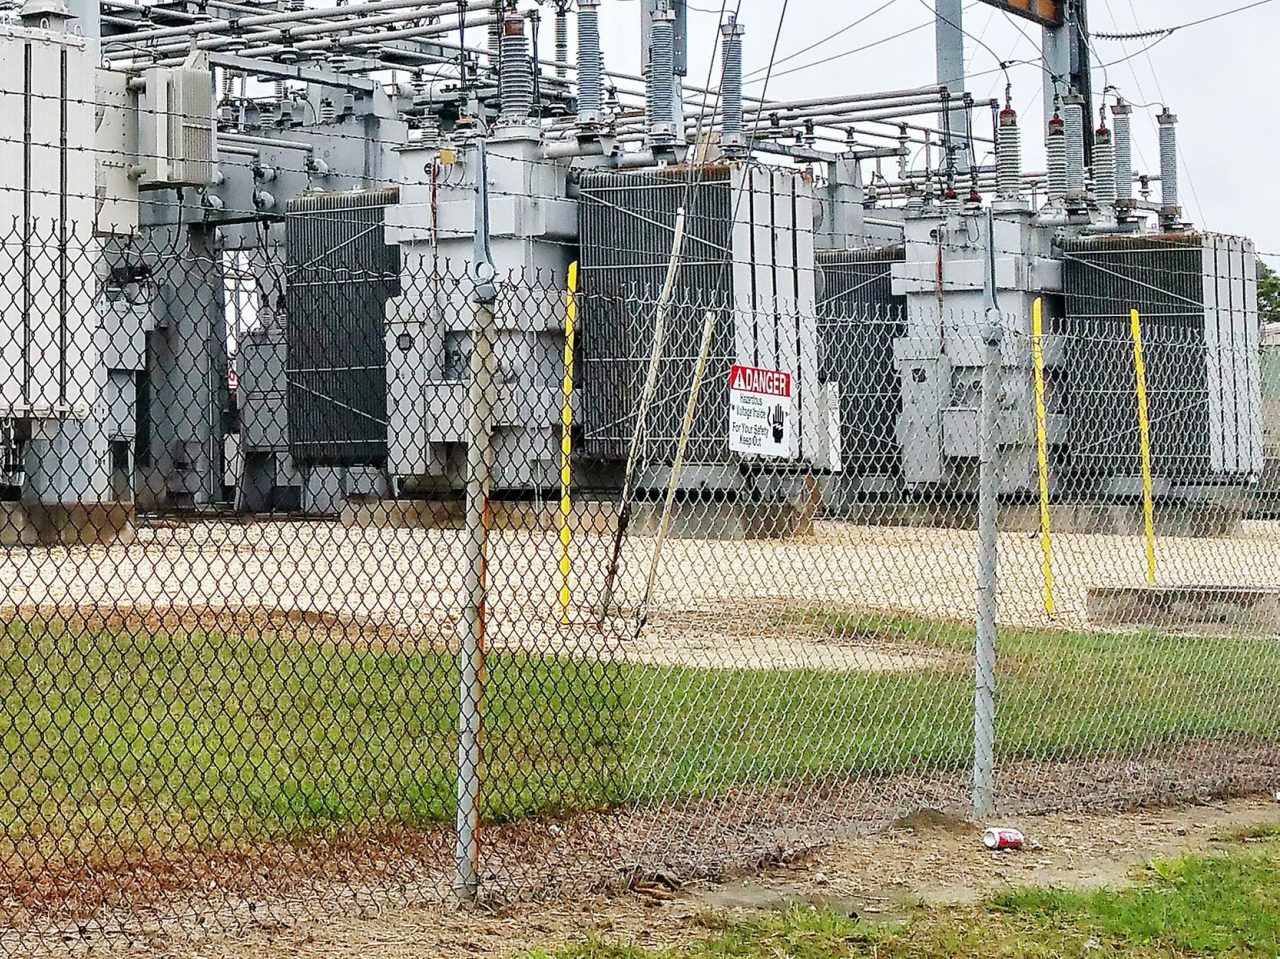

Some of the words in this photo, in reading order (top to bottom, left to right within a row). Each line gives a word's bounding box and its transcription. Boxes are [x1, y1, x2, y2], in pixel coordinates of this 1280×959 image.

[745, 369, 787, 395] DANGER
[732, 421, 740, 433] For
[741, 422, 753, 434] Your
[753, 424, 769, 439] Safety
[739, 434, 752, 448] Keep
[752, 435, 762, 447] Out
